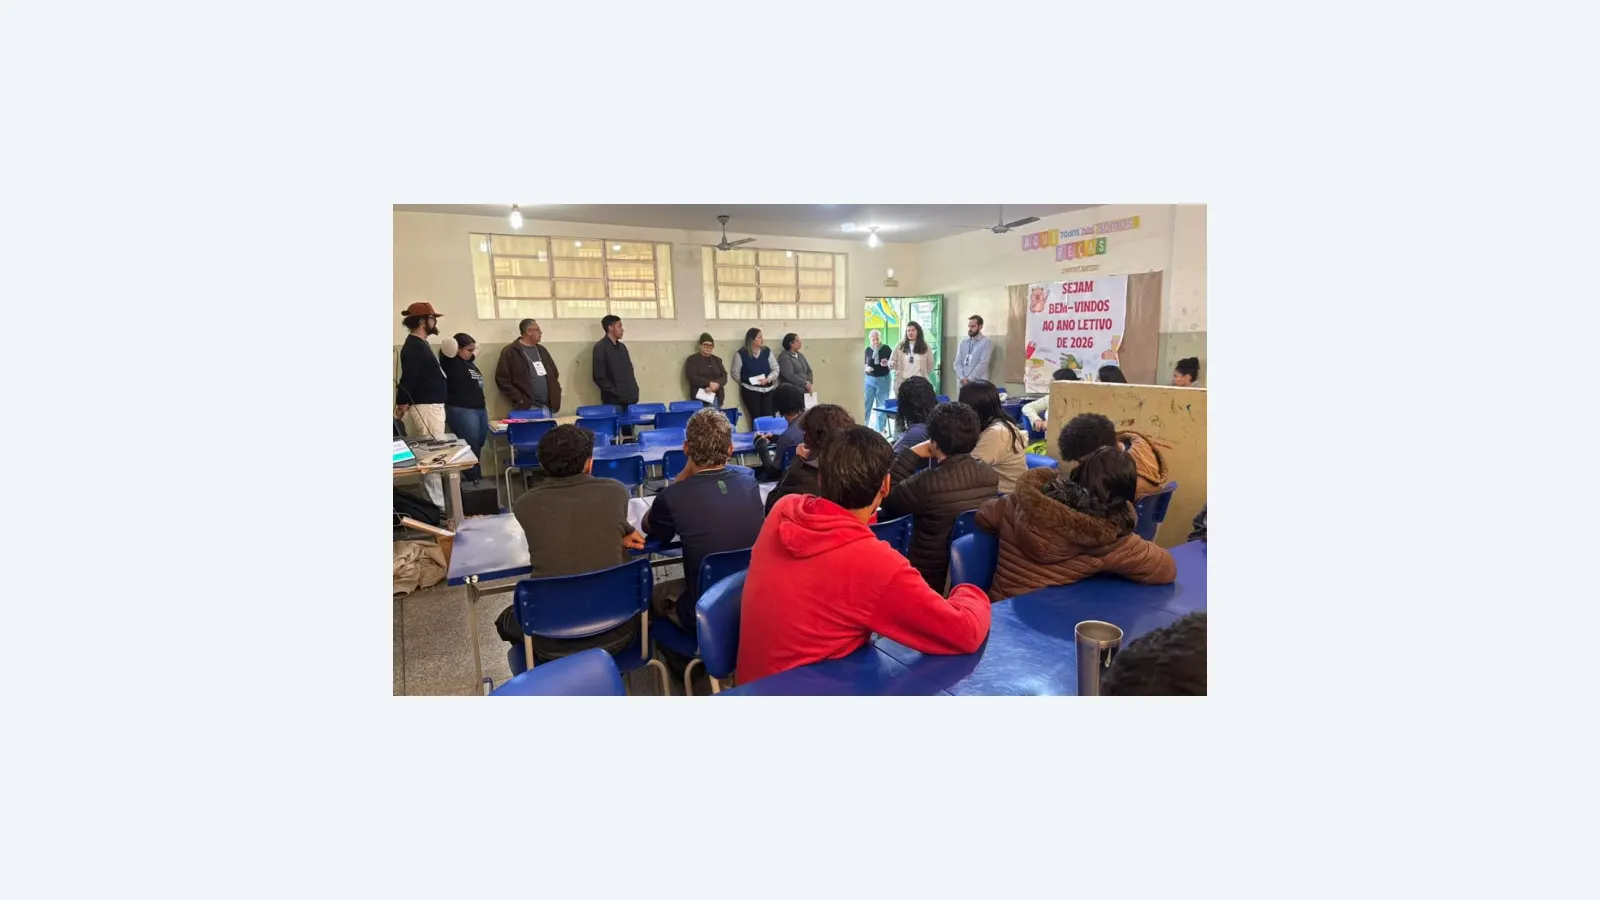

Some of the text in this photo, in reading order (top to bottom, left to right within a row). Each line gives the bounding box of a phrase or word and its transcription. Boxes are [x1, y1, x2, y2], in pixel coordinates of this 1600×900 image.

[1062, 281, 1094, 294] SEJAM
[1048, 300, 1110, 314] BEM-VINDOS
[1042, 318, 1113, 331] AO ANO LETIVO
[1056, 337, 1094, 348] DE 2026
